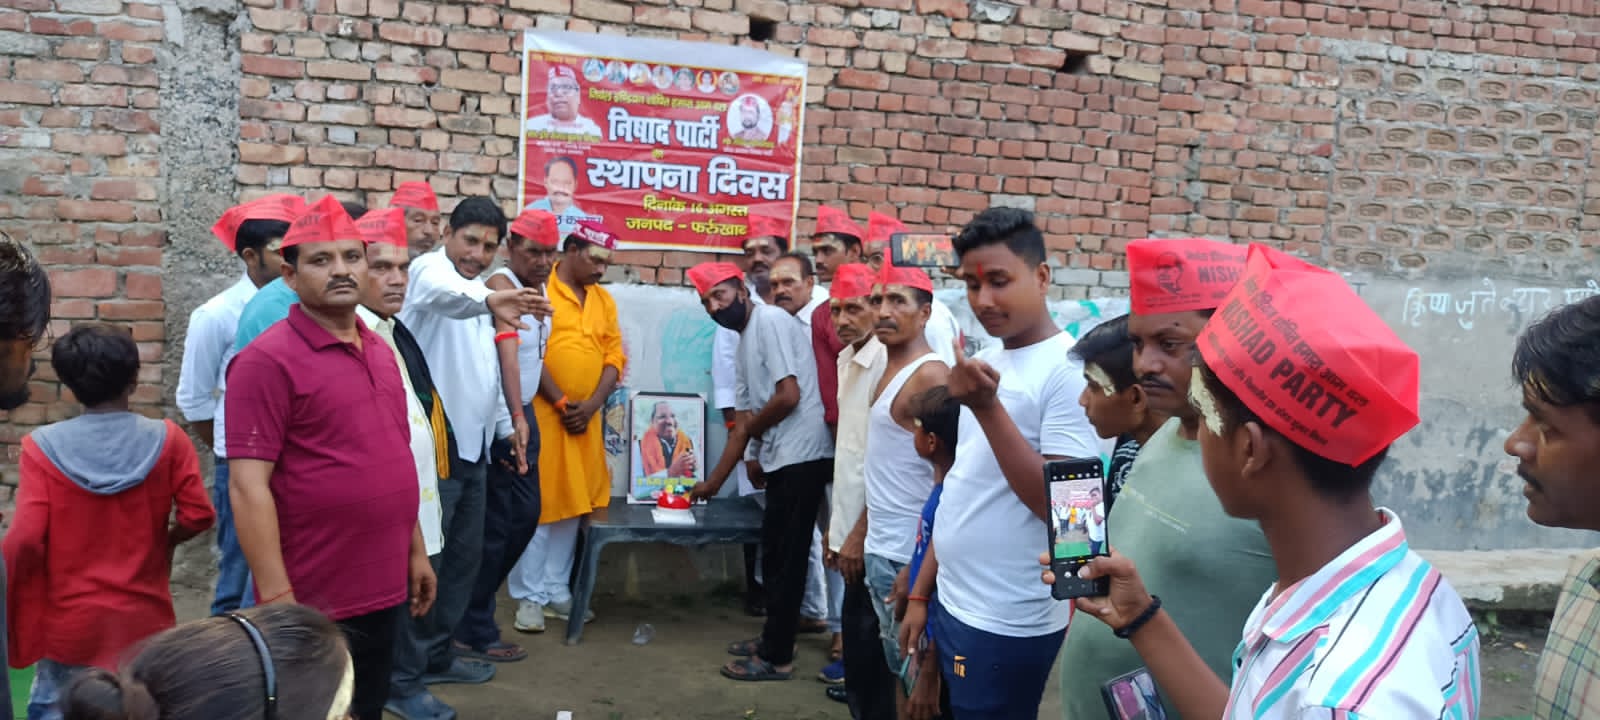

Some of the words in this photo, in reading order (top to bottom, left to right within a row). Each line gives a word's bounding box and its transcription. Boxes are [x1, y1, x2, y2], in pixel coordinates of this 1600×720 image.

[607, 106, 672, 146] निषाद
[673, 115, 720, 150] पार्टी
[586, 157, 700, 193] स्थापना
[707, 156, 790, 200] दिवस
[626, 217, 673, 231] जनपद
[643, 195, 685, 213] दिनांक
[691, 203, 703, 213] 16
[706, 205, 748, 217] अगस्त
[1221, 297, 1276, 366] NISHAD
[1269, 357, 1358, 428] PARTY
